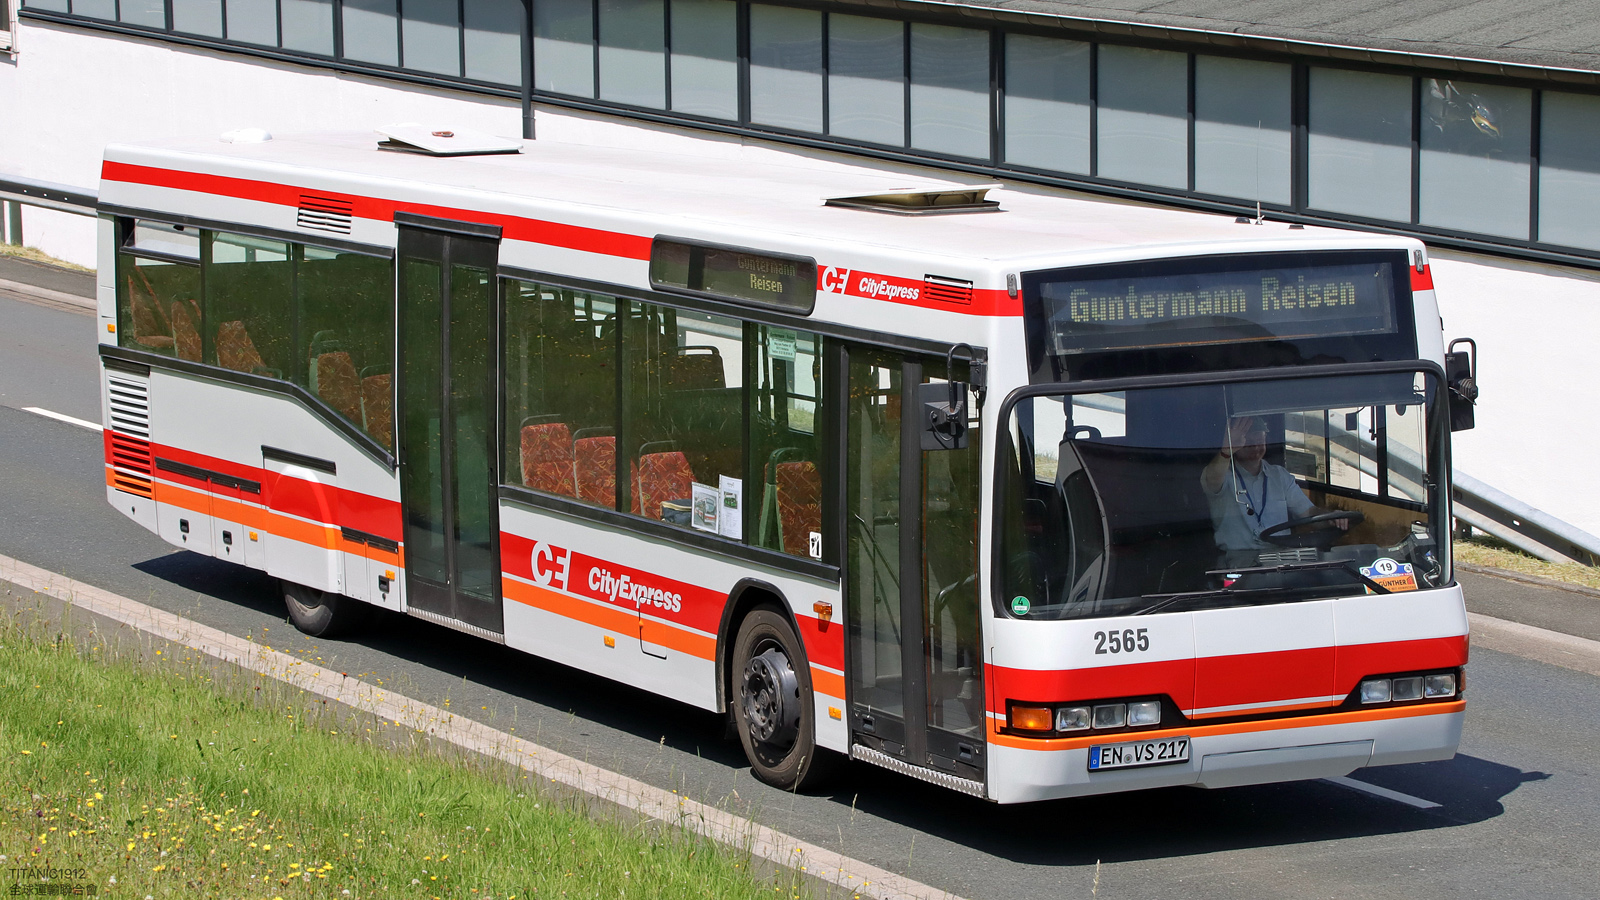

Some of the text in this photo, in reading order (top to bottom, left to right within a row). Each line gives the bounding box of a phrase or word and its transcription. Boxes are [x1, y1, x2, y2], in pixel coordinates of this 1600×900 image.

[749, 273, 783, 293] Reisen
[858, 277, 920, 301] CityExpress
[1069, 275, 1355, 323] Guntermann Reisen
[1379, 562, 1393, 572] 19
[588, 566, 682, 613] CityExpress
[1017, 597, 1024, 606] 4
[1094, 628, 1149, 654] 2565
[1101, 746, 1123, 765] EN
[1134, 743, 1155, 762] VS
[1157, 740, 1188, 760] 217
